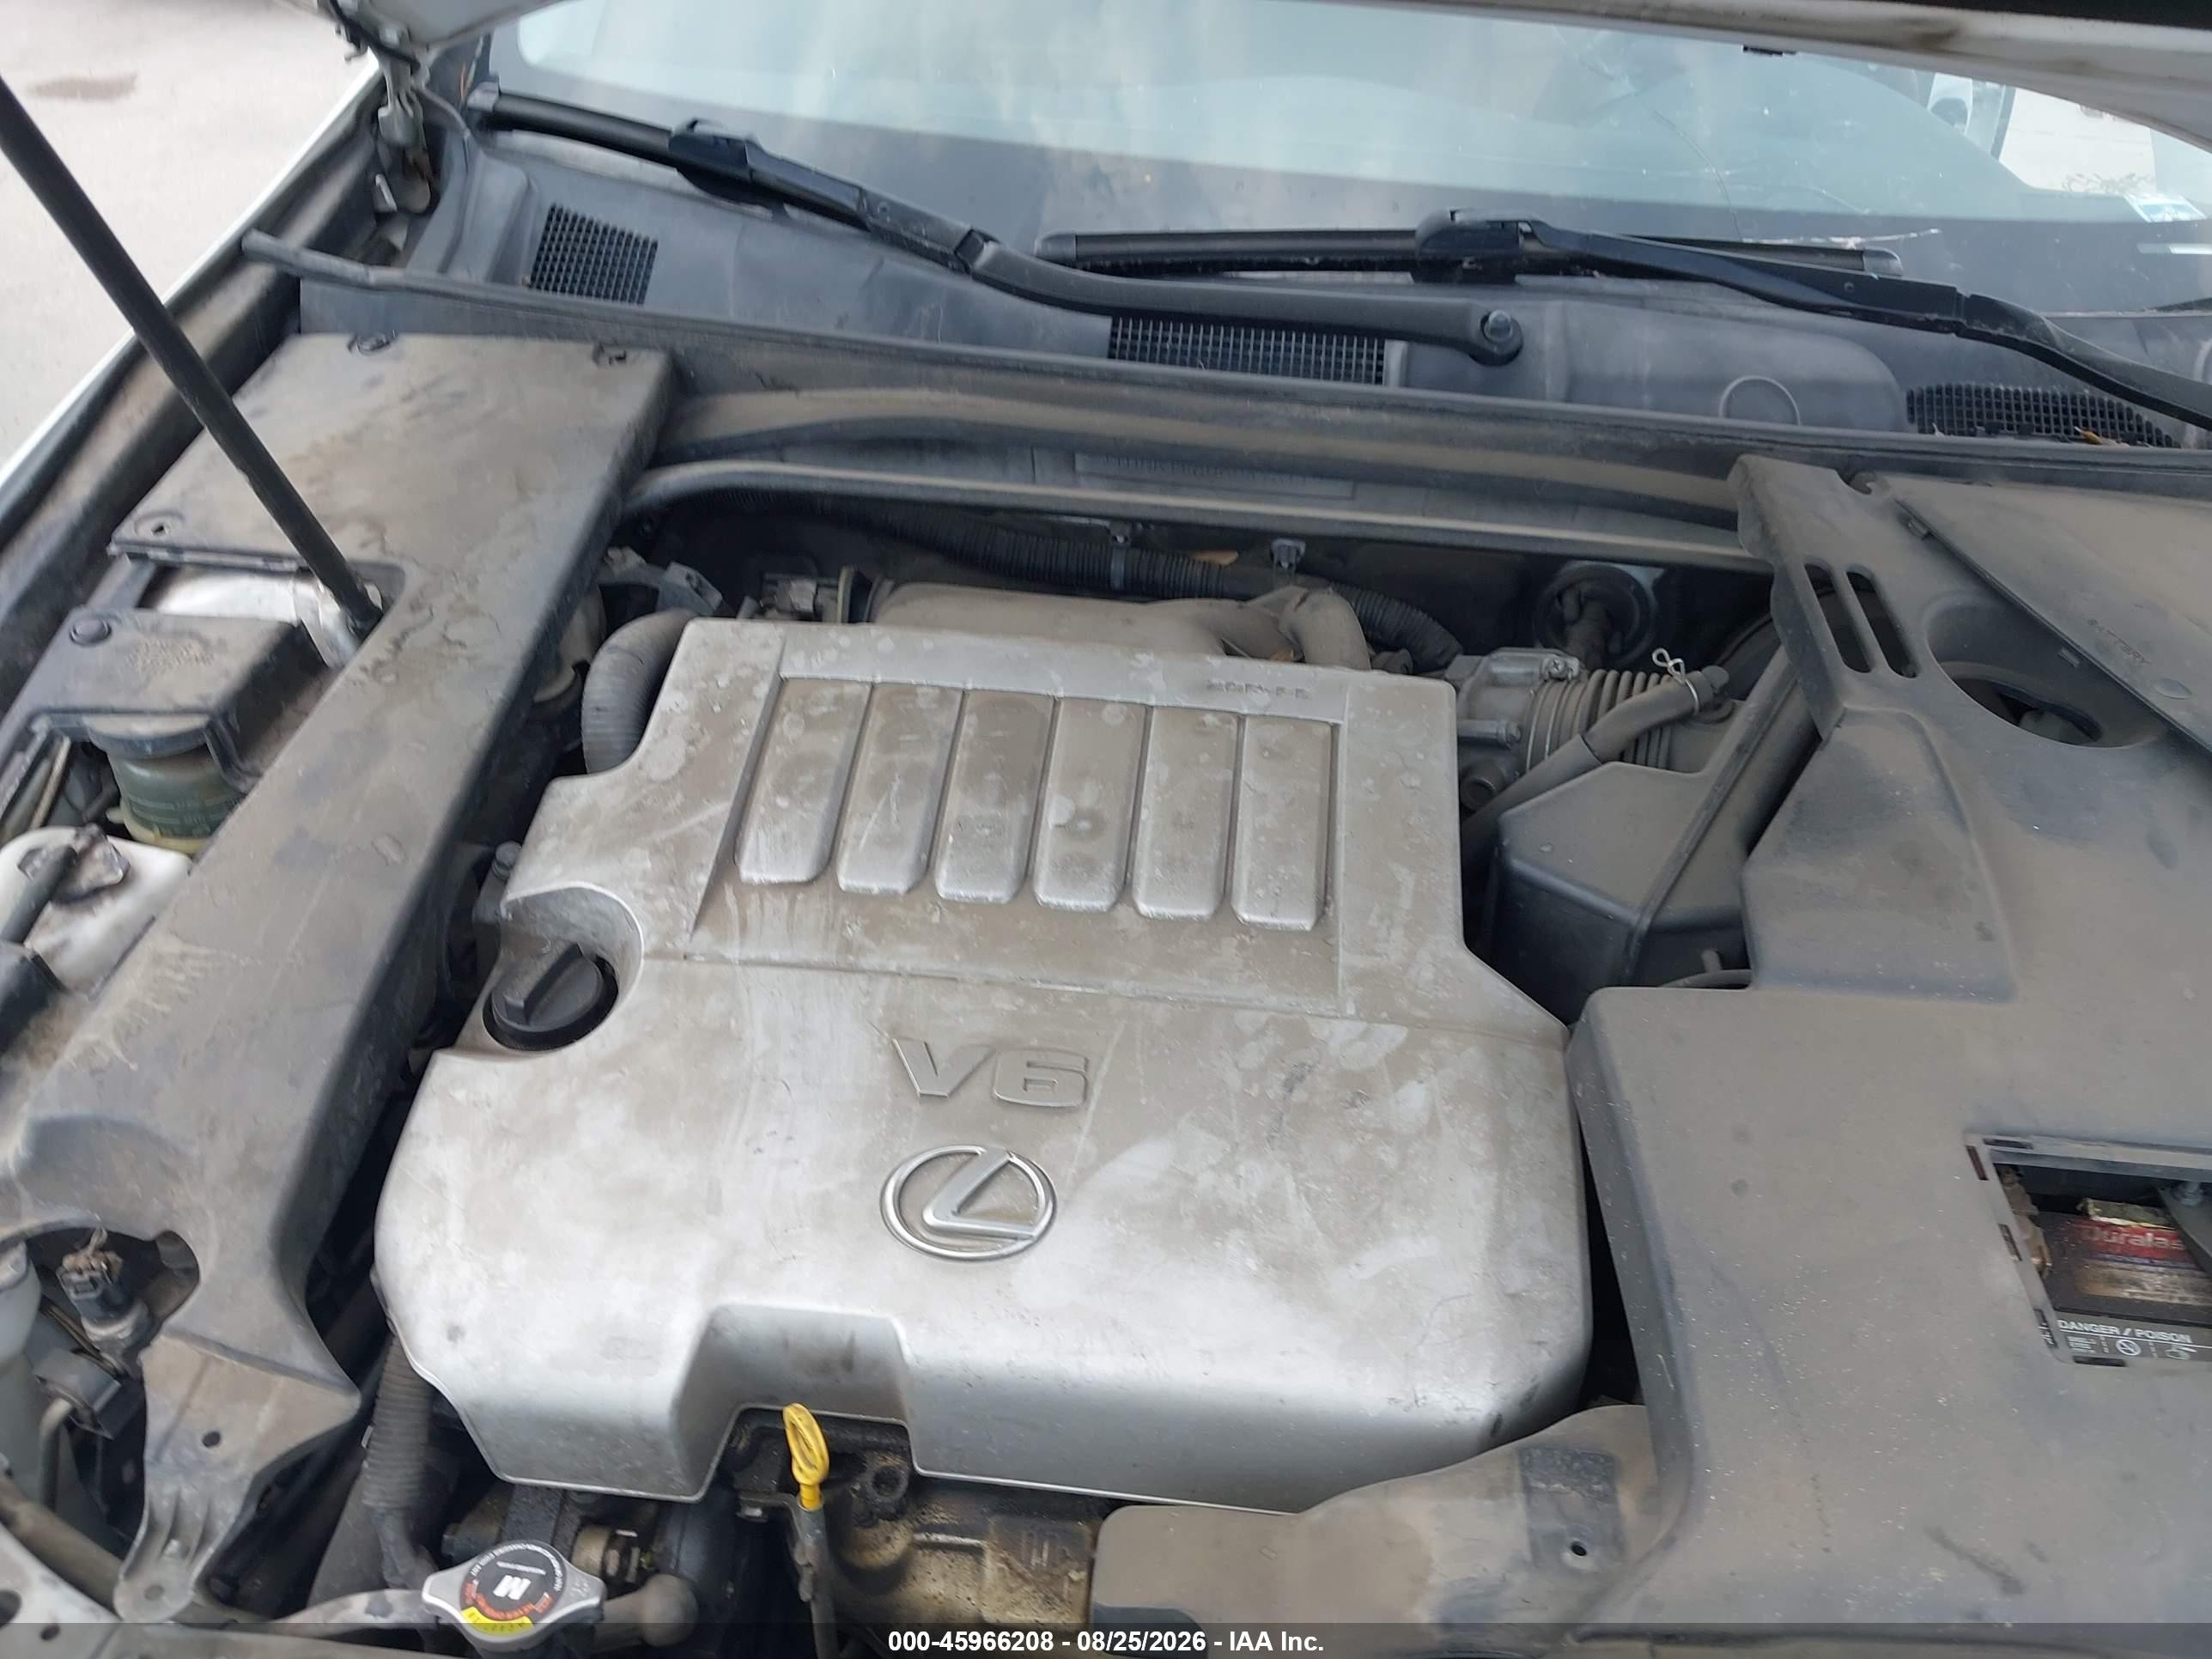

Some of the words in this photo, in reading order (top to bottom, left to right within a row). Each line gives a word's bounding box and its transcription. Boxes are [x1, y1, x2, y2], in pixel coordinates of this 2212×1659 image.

[891, 1036, 1089, 1108] V6
[2057, 1319, 2121, 1336] DANGER
[2133, 1328, 2193, 1344] POISON
